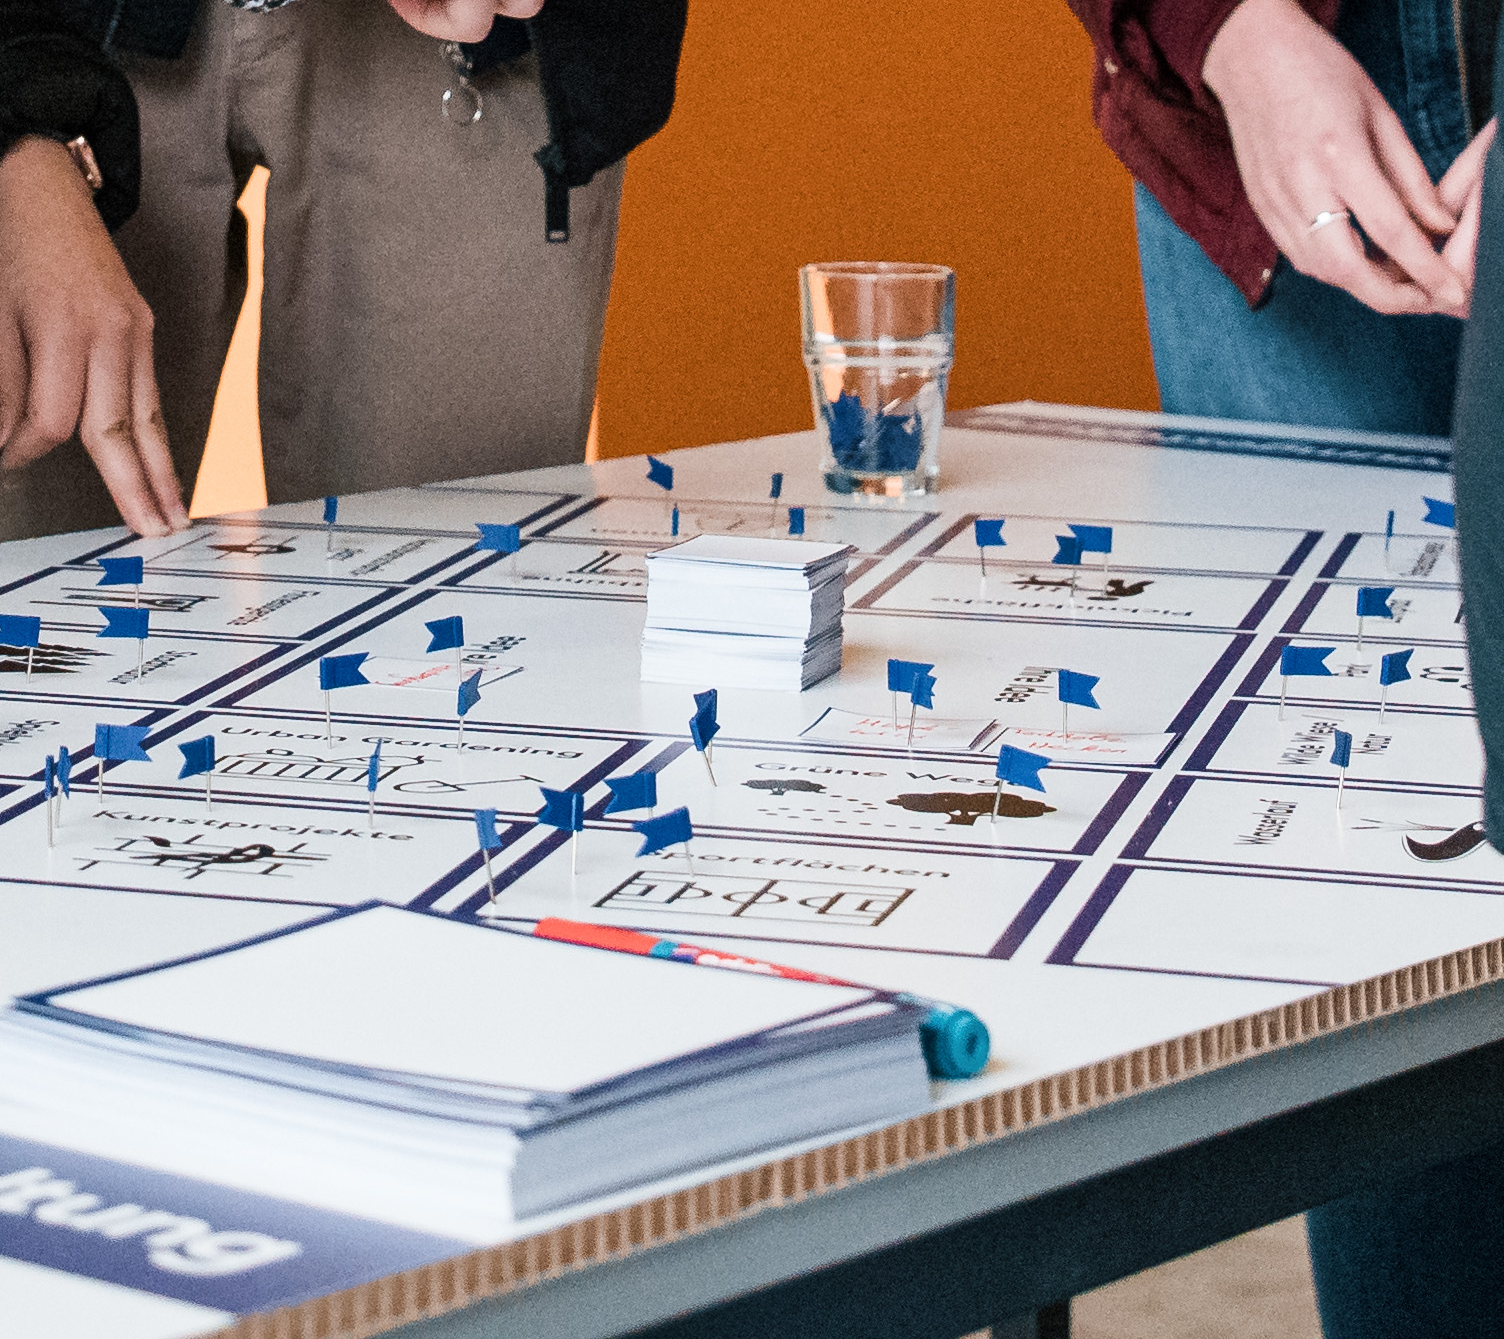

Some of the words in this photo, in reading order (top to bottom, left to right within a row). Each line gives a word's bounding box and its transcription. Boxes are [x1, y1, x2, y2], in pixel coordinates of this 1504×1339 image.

[994, 683, 1054, 702] Idee
[221, 726, 347, 742] Urban
[362, 736, 584, 759] Gardening
[1277, 744, 1325, 764] Wilde
[1350, 733, 1392, 755] Natur
[755, 761, 888, 777] Grüne
[905, 770, 1021, 787] Weg
[92, 809, 414, 841] Kunstprojekte
[1233, 798, 1298, 845] Wasserlauf
[653, 851, 950, 878] portflächen
